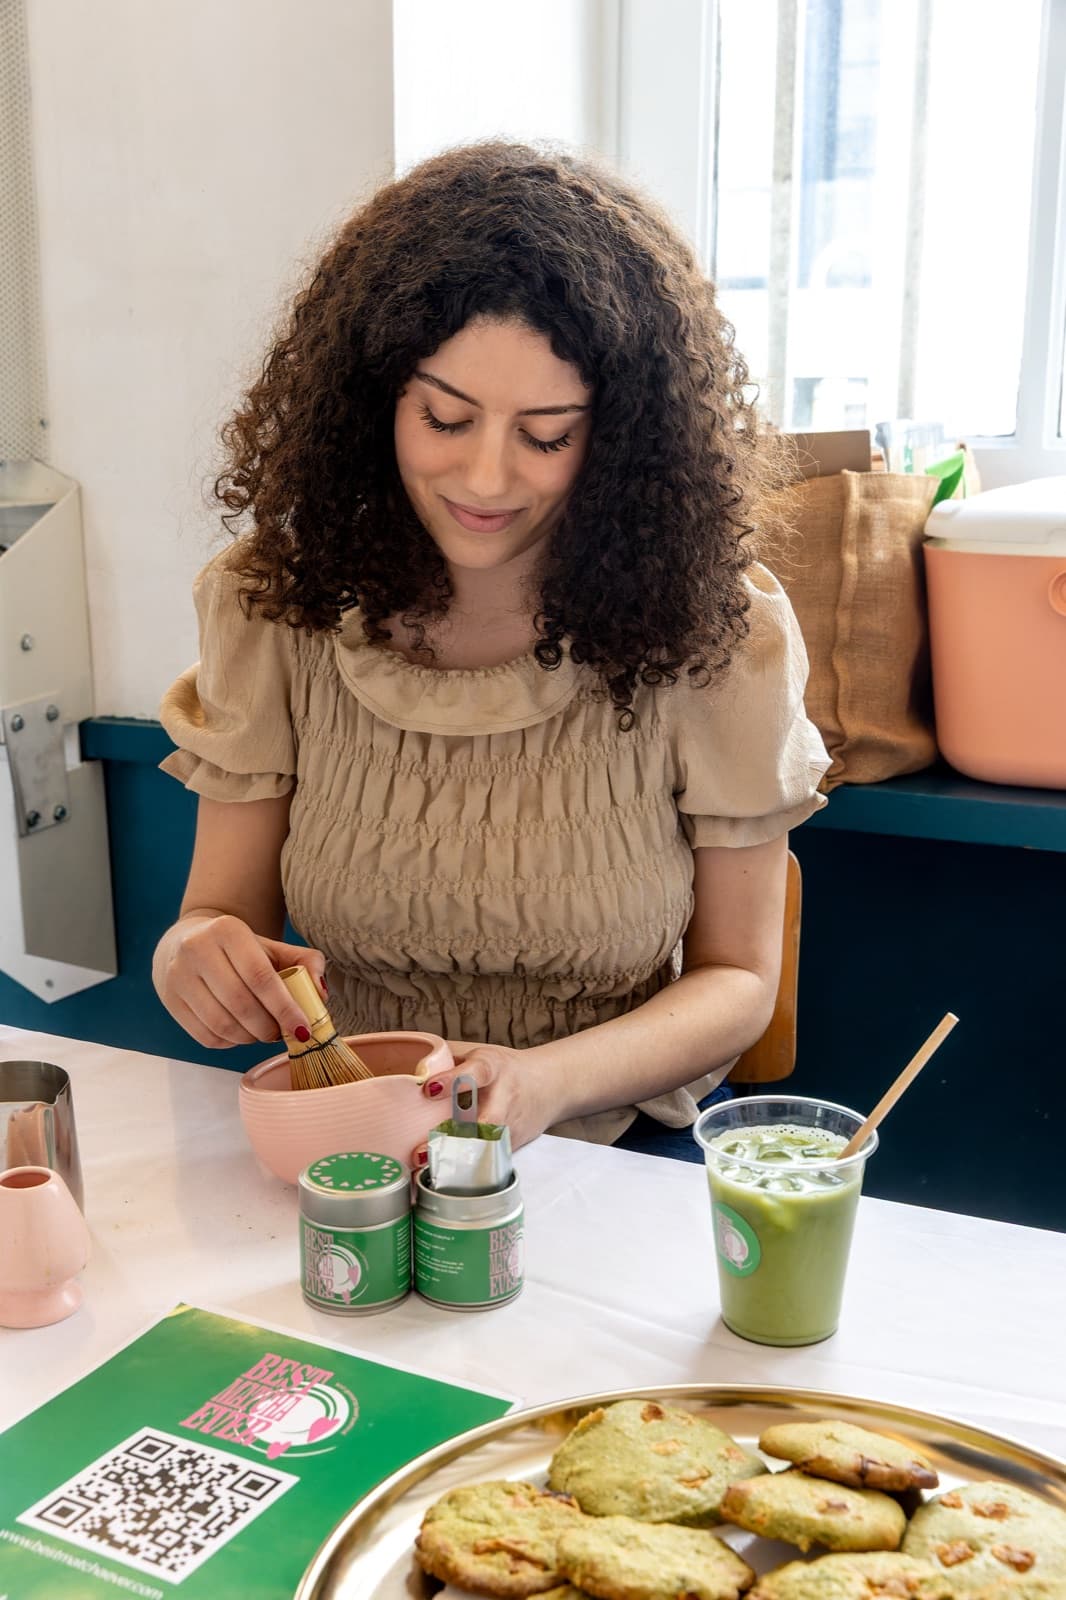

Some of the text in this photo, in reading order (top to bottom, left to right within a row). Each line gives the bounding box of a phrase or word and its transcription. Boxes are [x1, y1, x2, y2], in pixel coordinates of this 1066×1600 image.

[304, 1224, 334, 1255] BEST
[241, 1352, 335, 1396] BEST
[210, 1377, 303, 1422] MATCHA
[178, 1401, 273, 1446] EVER
